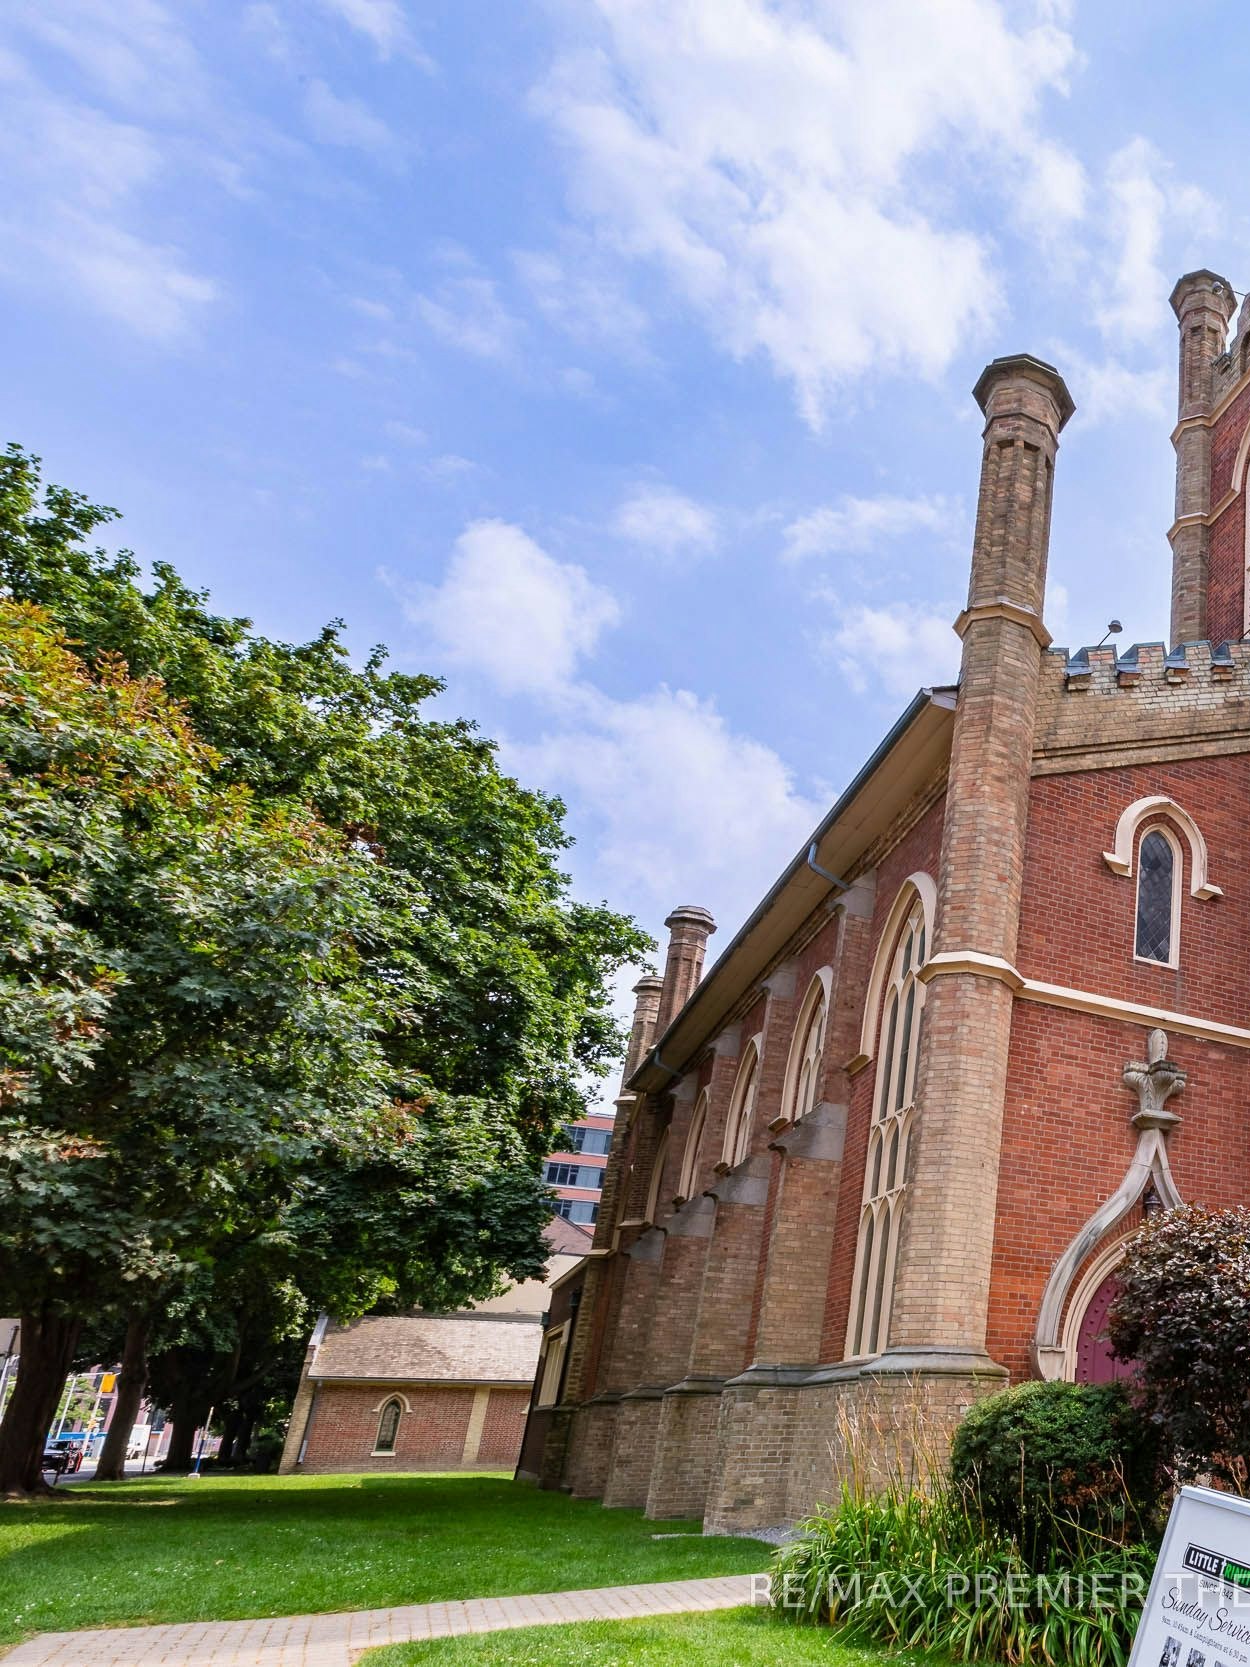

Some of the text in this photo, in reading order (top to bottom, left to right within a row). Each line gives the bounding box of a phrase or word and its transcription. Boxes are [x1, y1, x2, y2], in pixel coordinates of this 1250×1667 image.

[1188, 1550, 1220, 1573] LITTLE
[1199, 1579, 1218, 1594] SINCE
[1161, 1586, 1209, 1629] Sunday
